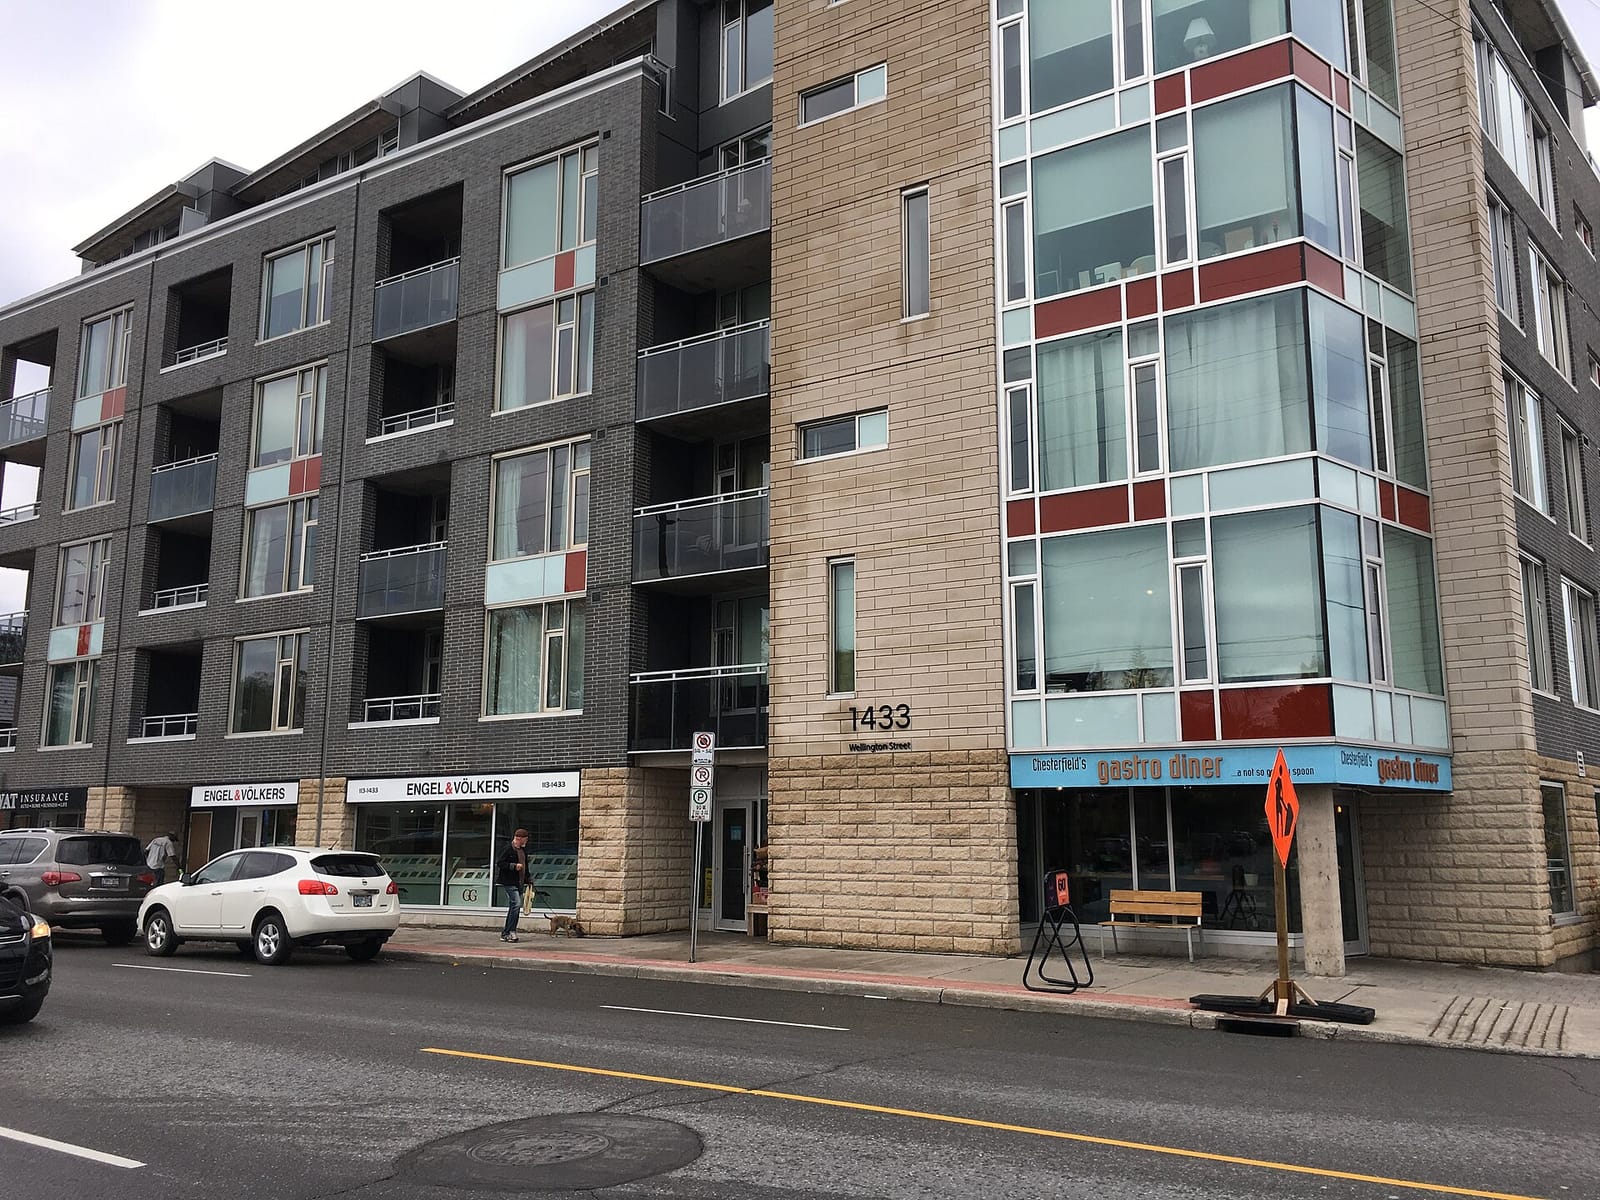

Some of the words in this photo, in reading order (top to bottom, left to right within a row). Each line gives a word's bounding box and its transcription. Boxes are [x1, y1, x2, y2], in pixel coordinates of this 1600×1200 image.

[848, 703, 911, 732] 1433
[849, 743, 888, 753] Wellington
[888, 741, 911, 751] Street
[1032, 756, 1087, 773] Chesterfield's
[1097, 754, 1162, 785] gastro
[1169, 753, 1224, 779] diner
[1243, 768, 1255, 777] not
[1256, 768, 1265, 777] so
[1292, 767, 1315, 777] spoon
[1377, 755, 1411, 784] gastro
[1413, 757, 1439, 784] diner
[20, 792, 69, 803] INSURANCE
